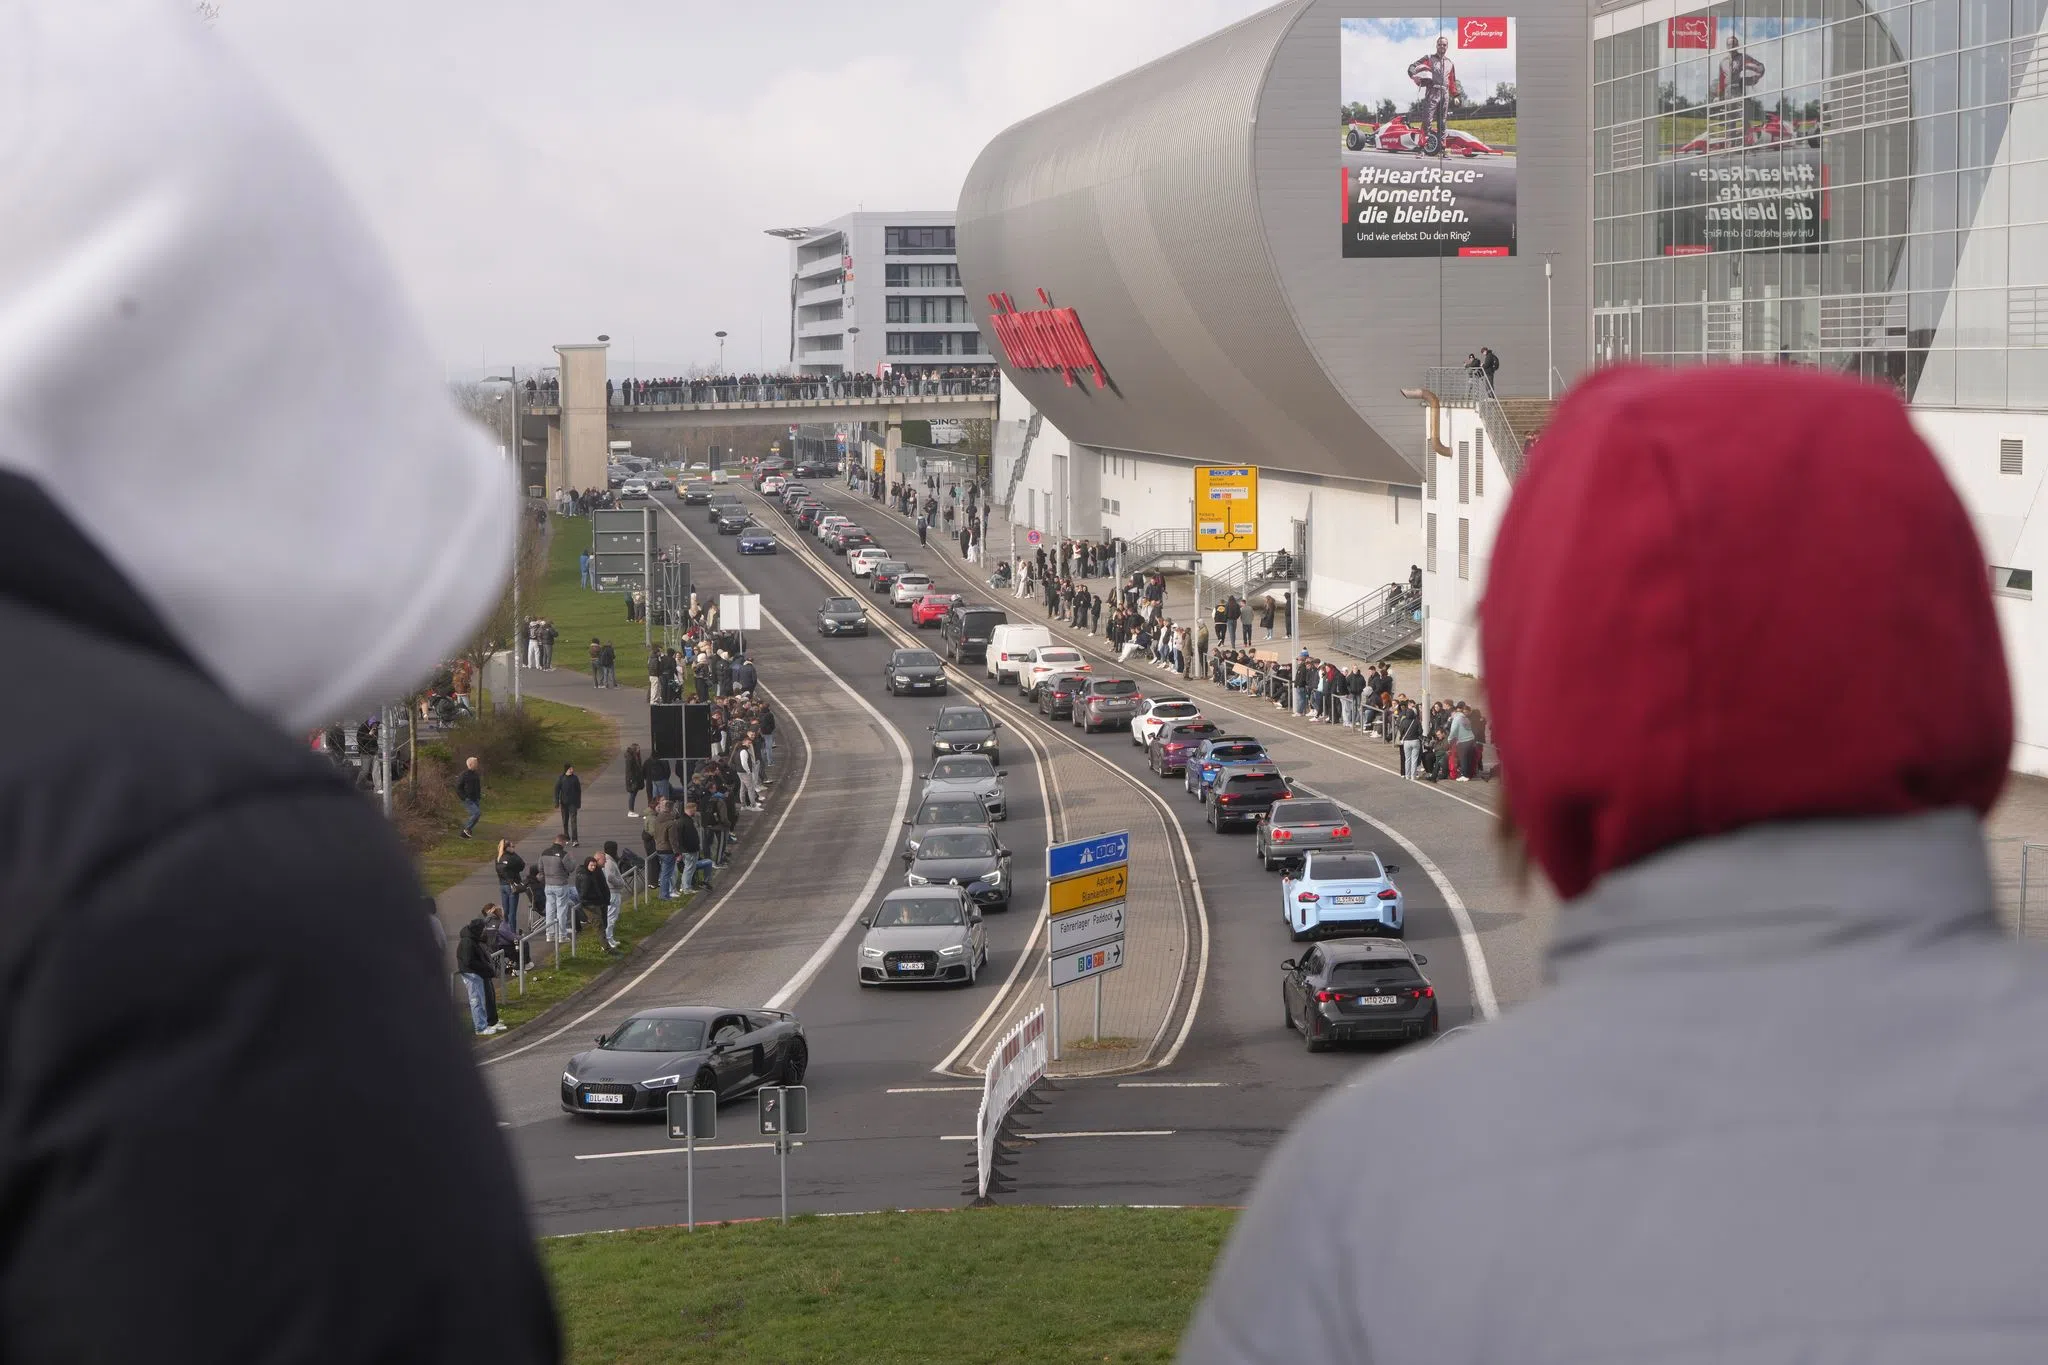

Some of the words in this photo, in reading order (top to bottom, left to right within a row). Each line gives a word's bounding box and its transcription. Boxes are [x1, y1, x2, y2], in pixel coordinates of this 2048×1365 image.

[1358, 166, 1484, 184] #HeartRace-
[1357, 185, 1456, 206] Momente,
[1358, 206, 1388, 224] die
[1393, 205, 1469, 224] bleiben.
[1357, 231, 1374, 241] Und
[1375, 232, 1390, 241] wie
[1391, 231, 1418, 241] erlebst
[1420, 231, 1432, 240] Du
[1433, 231, 1449, 240] den
[1450, 231, 1471, 243] Ring?
[1096, 875, 1115, 887] Aachen
[1082, 887, 1115, 902] Blankenheim
[1060, 918, 1090, 933] Fahrerlager
[1092, 912, 1114, 925] Paddock
